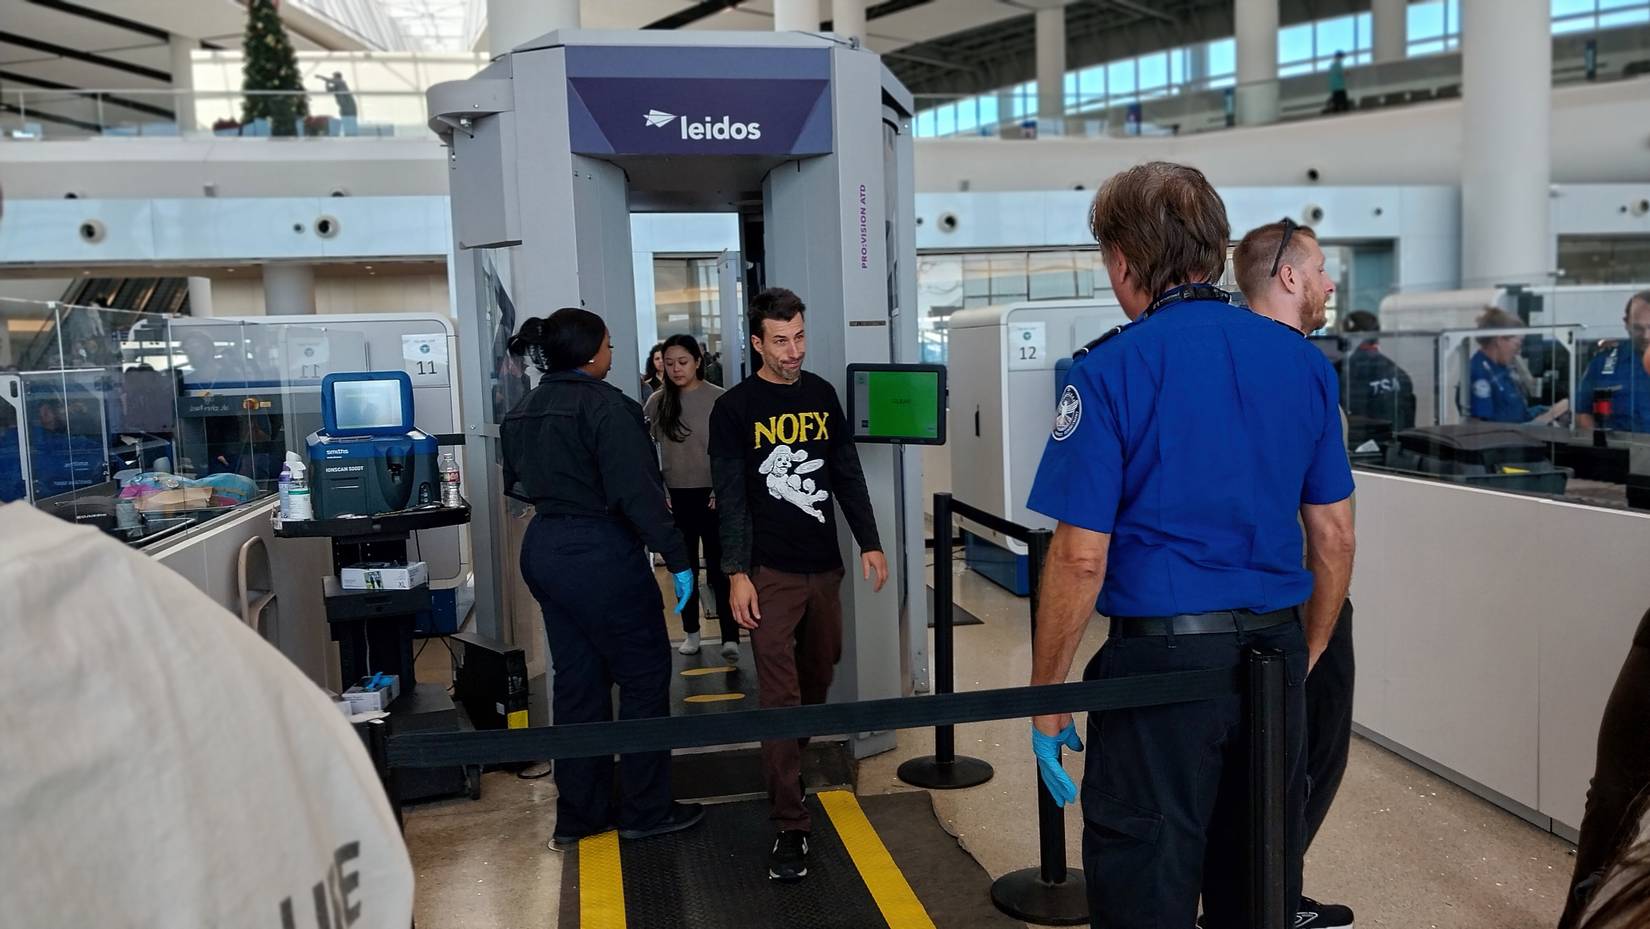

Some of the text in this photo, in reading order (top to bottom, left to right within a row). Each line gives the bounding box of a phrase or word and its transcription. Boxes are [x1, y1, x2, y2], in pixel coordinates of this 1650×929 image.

[681, 115, 761, 140] leidos
[859, 184, 868, 269] PRO:VISION ATD
[1019, 346, 1037, 360] 12
[416, 360, 438, 376] 11
[753, 411, 830, 449] NOFX
